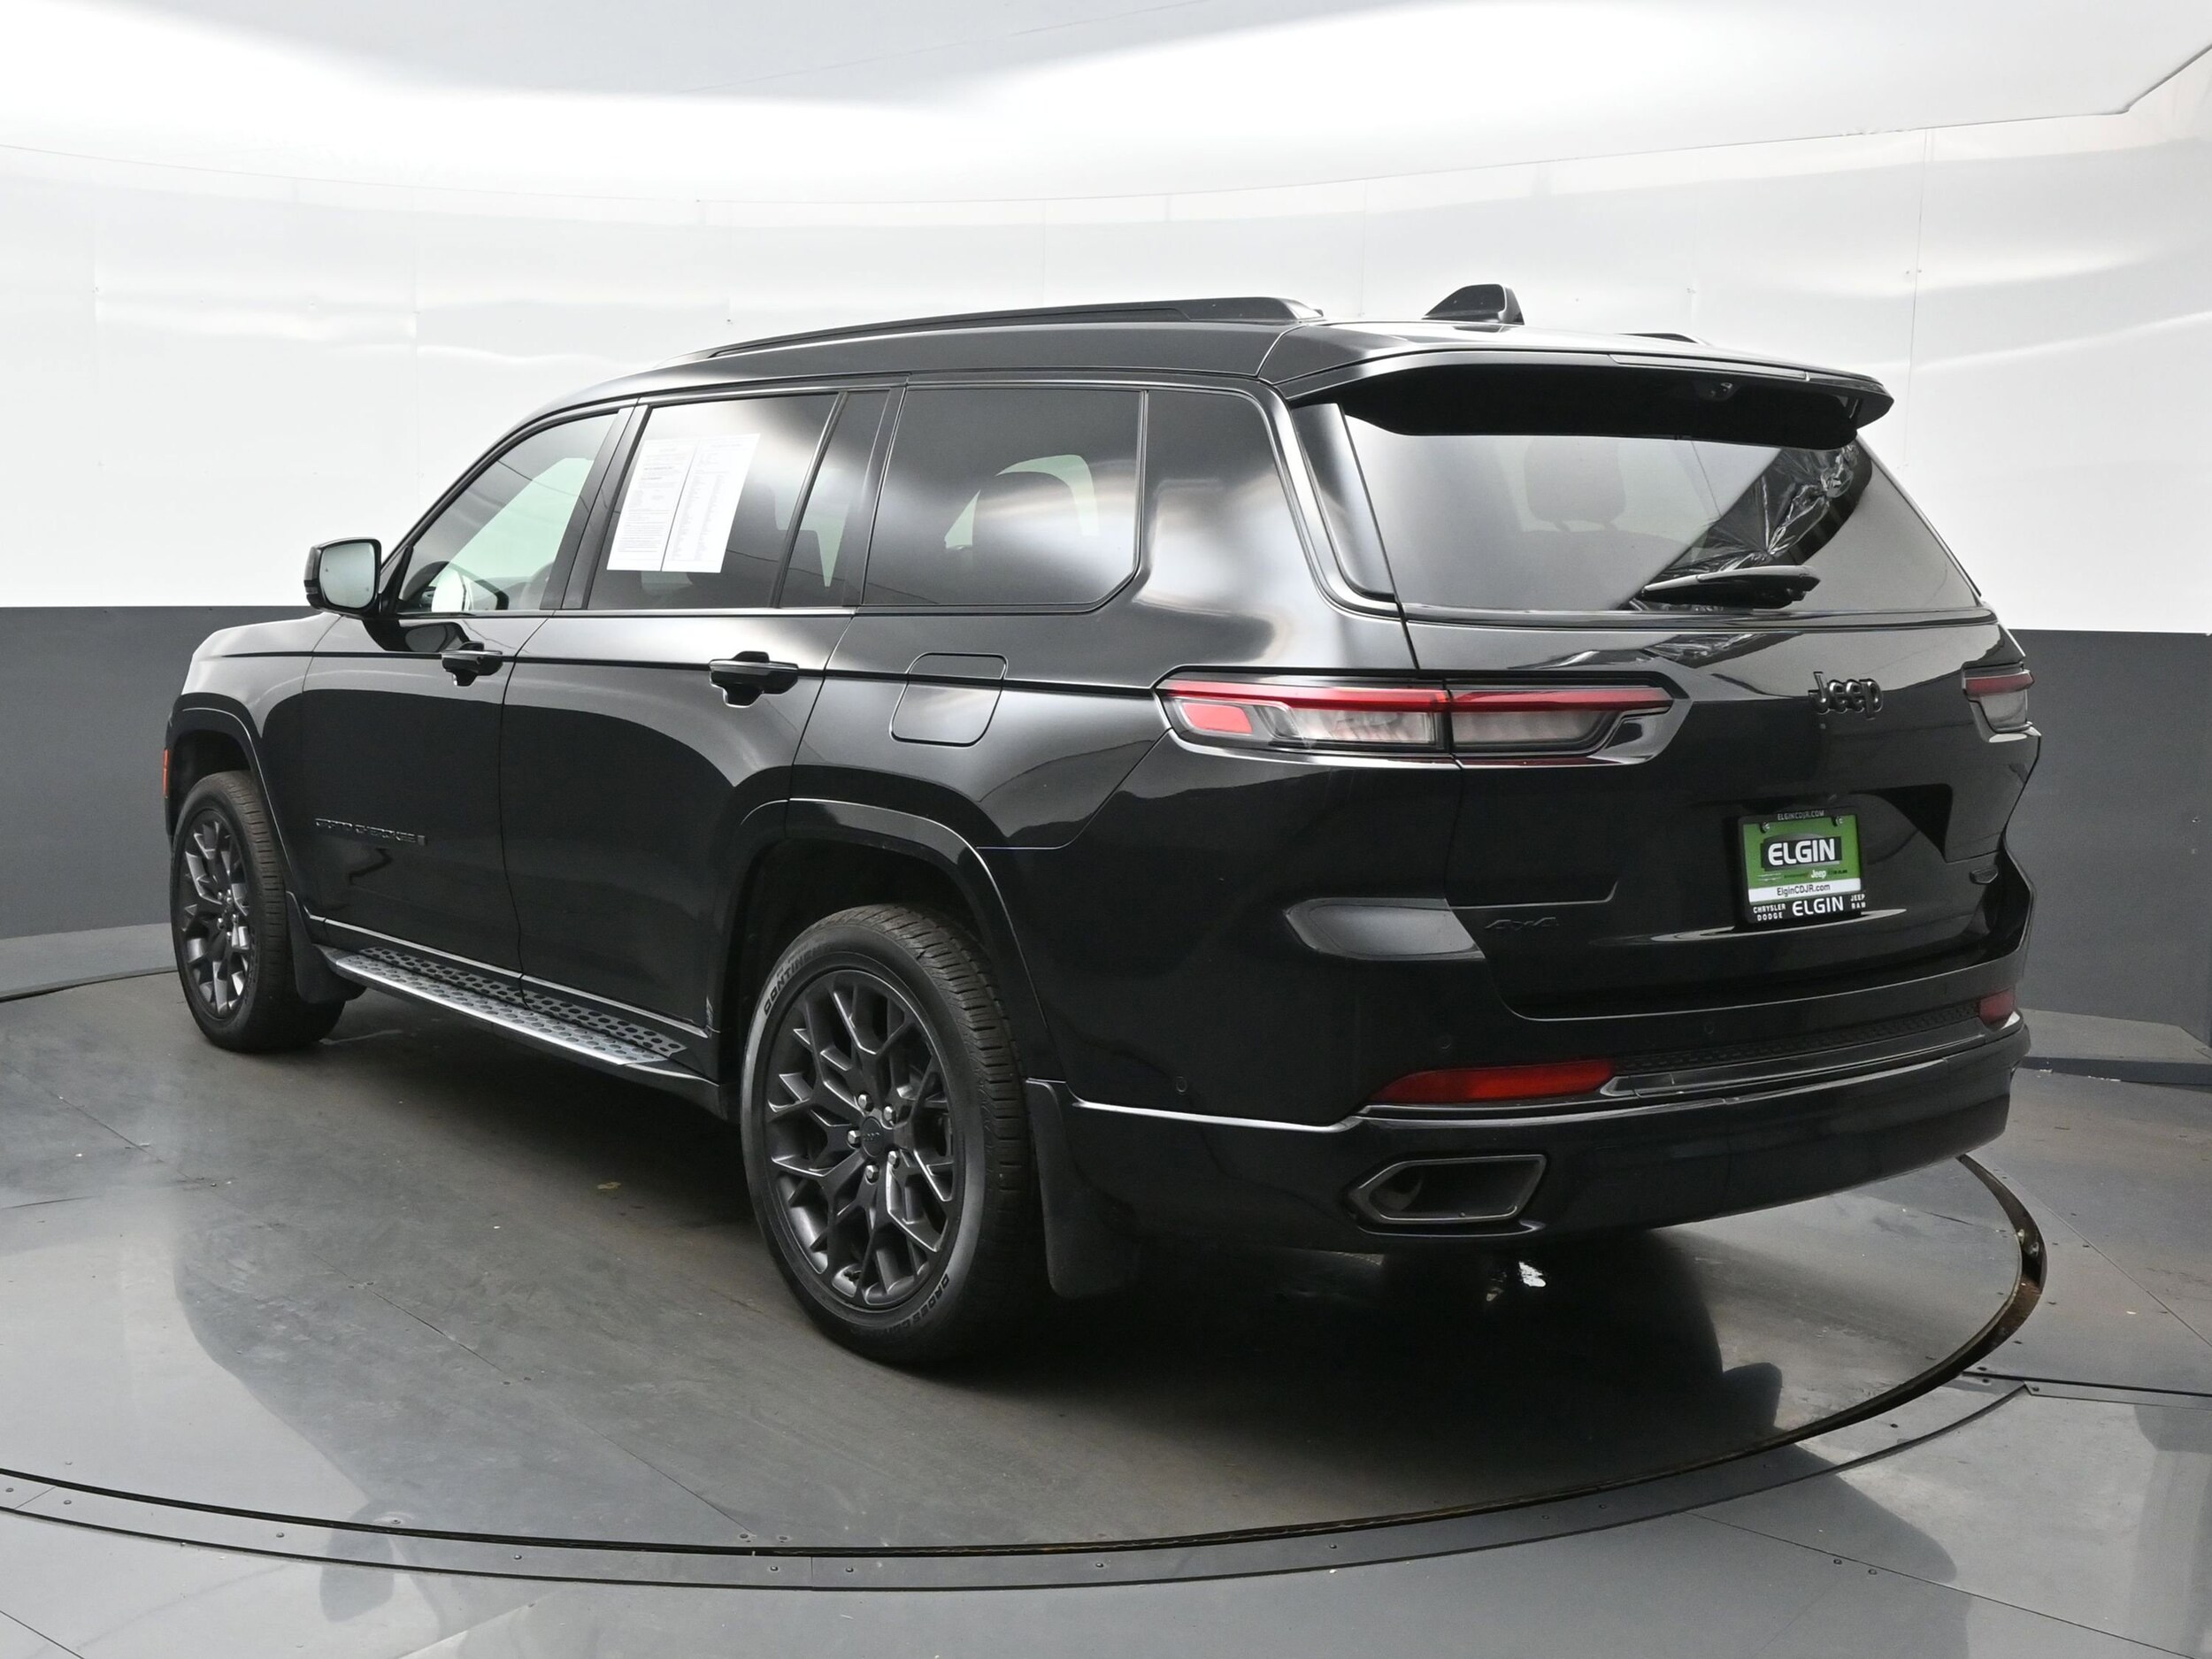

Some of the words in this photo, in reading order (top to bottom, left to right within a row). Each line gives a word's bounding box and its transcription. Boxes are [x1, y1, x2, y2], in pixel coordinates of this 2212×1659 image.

[1808, 671, 1884, 720] Jeep
[1777, 810, 1824, 821] ELGINCDJR.COM
[1768, 838, 1836, 866] ELGIN
[1810, 869, 1827, 879] Jeep
[1777, 883, 1831, 897] ElginCDJR.com
[1753, 903, 1786, 914] CHRYSLER
[1792, 895, 1844, 917] ELGIN
[1756, 911, 1783, 922] DODGE
